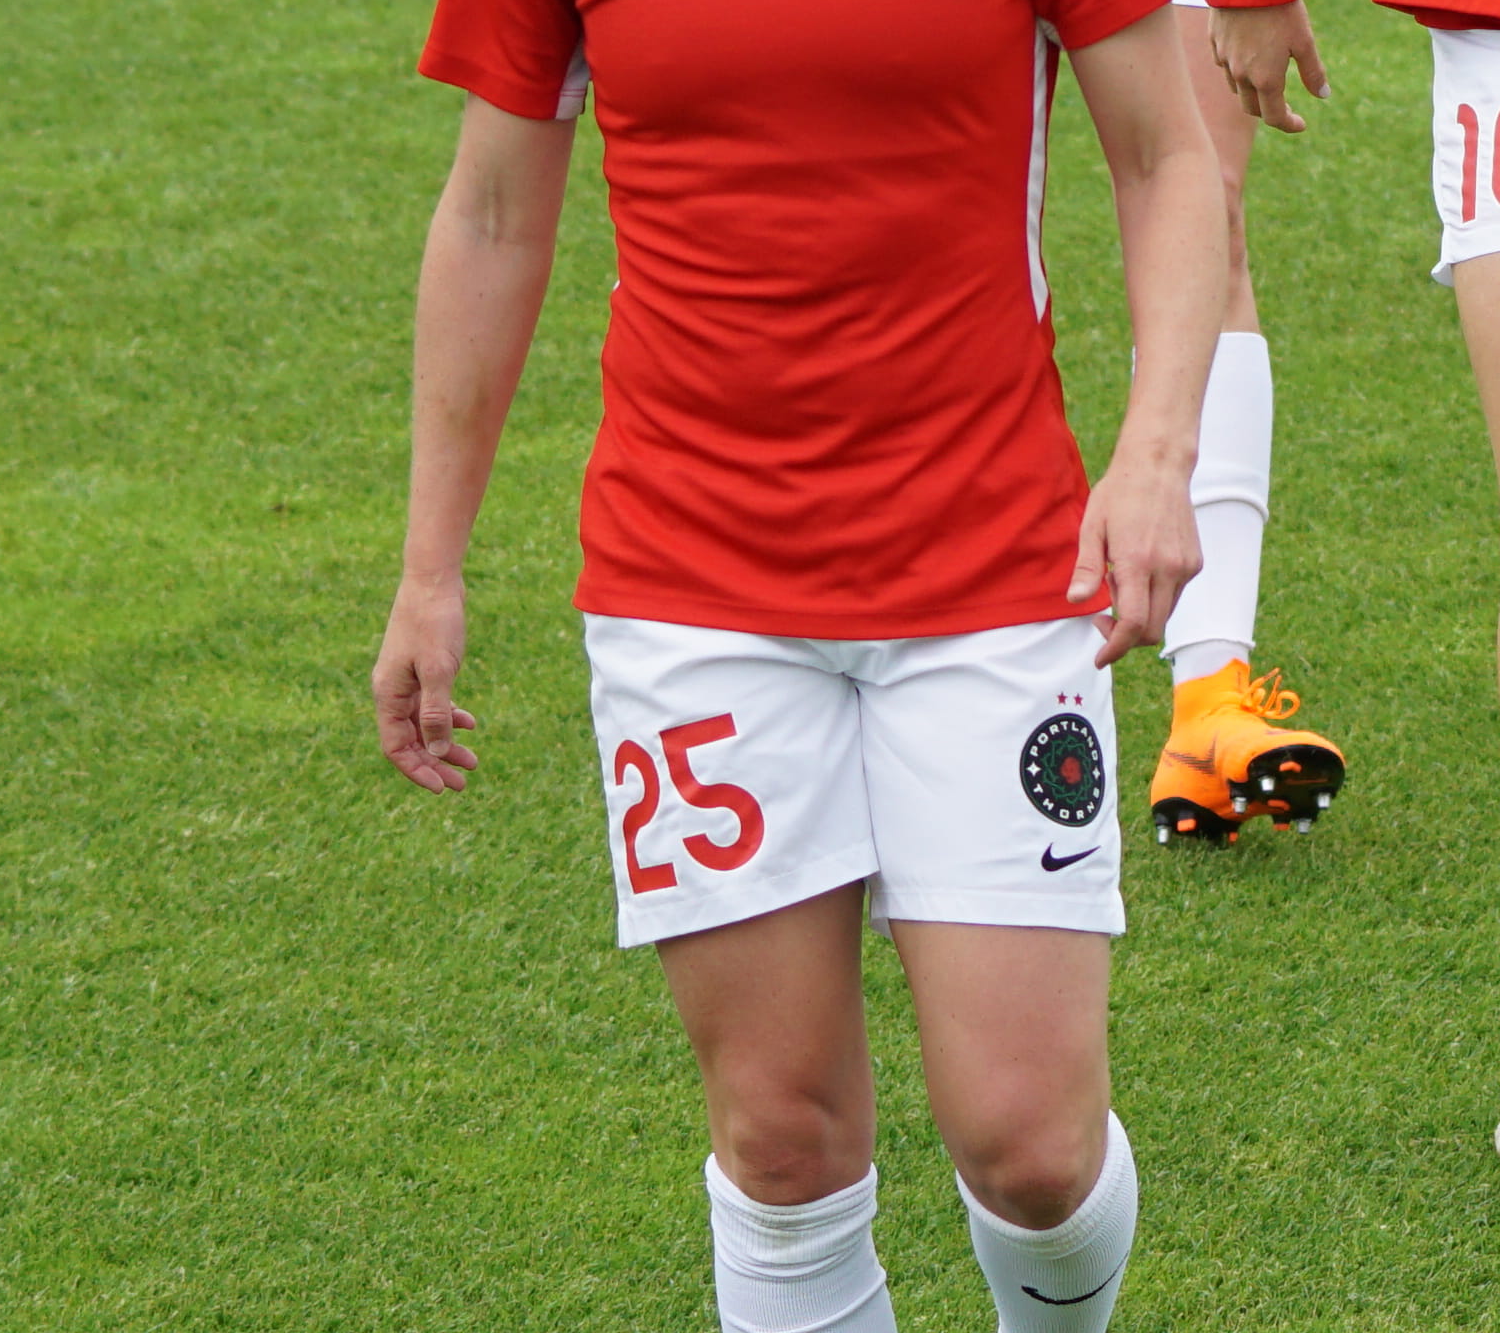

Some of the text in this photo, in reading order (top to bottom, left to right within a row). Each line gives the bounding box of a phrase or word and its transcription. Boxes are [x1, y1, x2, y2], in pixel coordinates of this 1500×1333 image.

[1029, 720, 1099, 761] PORTLAND
[614, 711, 765, 894] 25
[1033, 783, 1100, 821] THORNS
